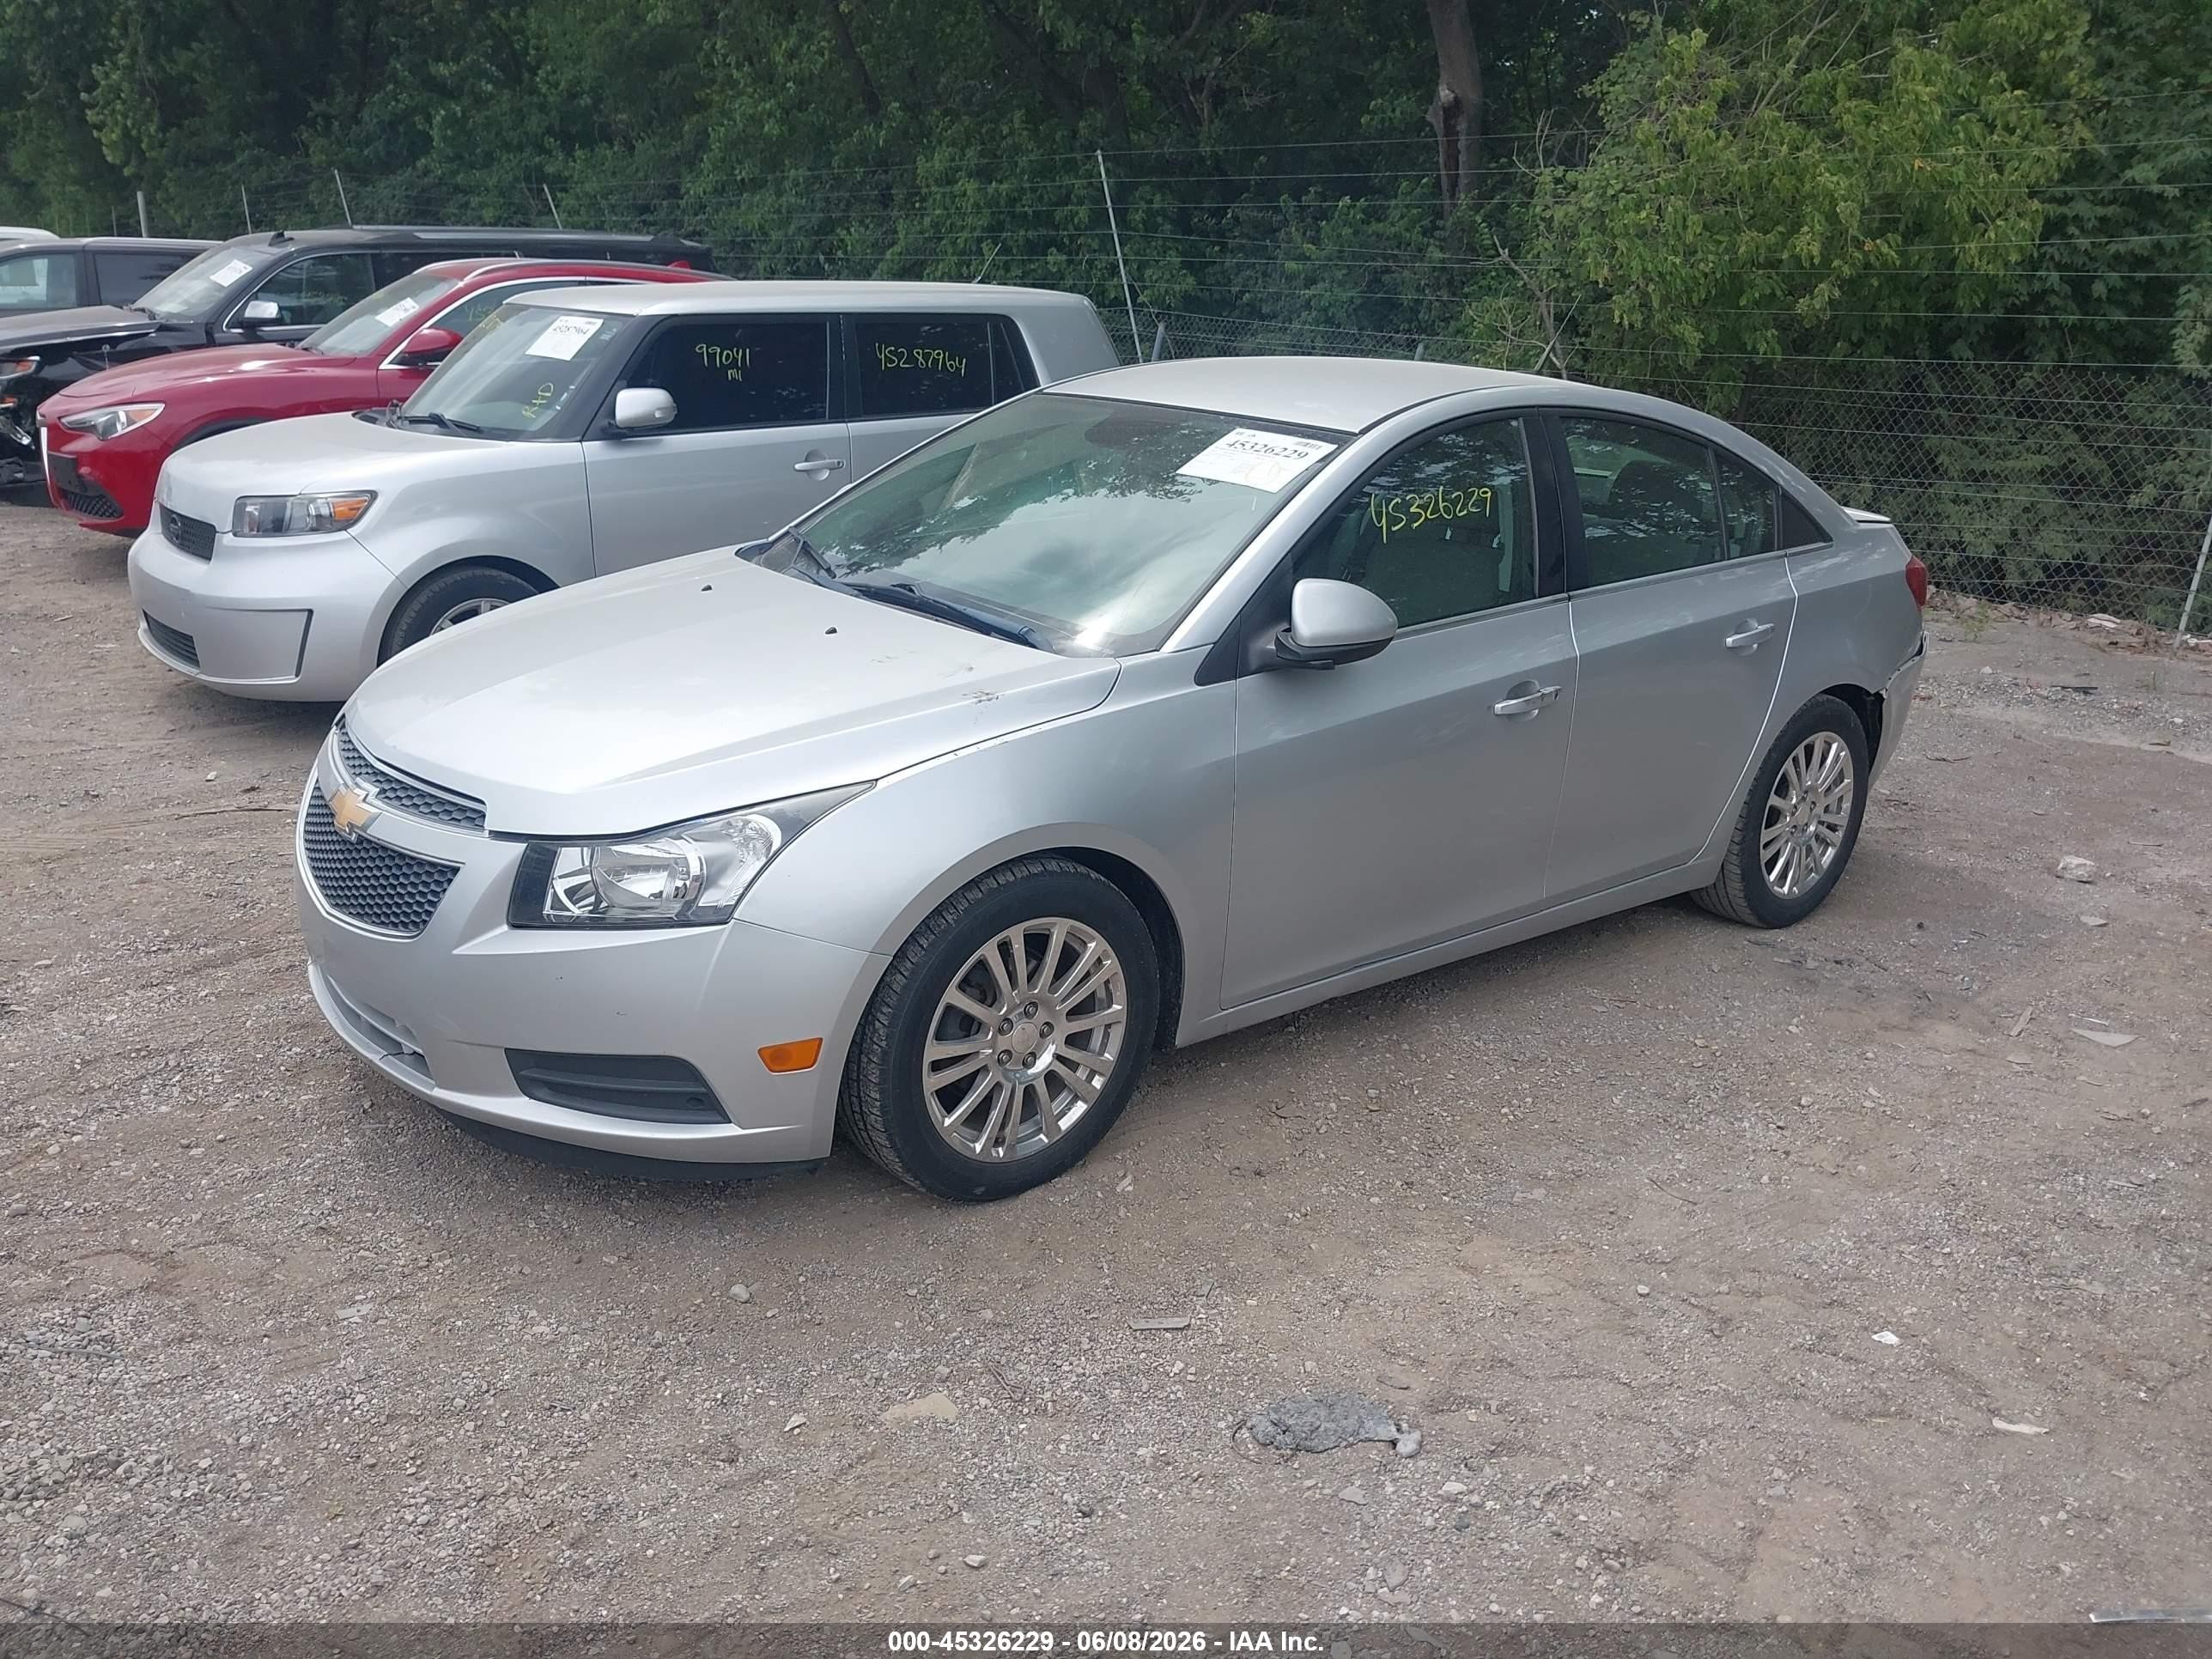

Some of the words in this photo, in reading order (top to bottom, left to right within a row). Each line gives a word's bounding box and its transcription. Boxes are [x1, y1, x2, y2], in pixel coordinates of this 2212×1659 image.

[695, 343, 750, 368] 99041
[1225, 439, 1310, 460] 45326229
[1370, 485, 1492, 544] 45326229
